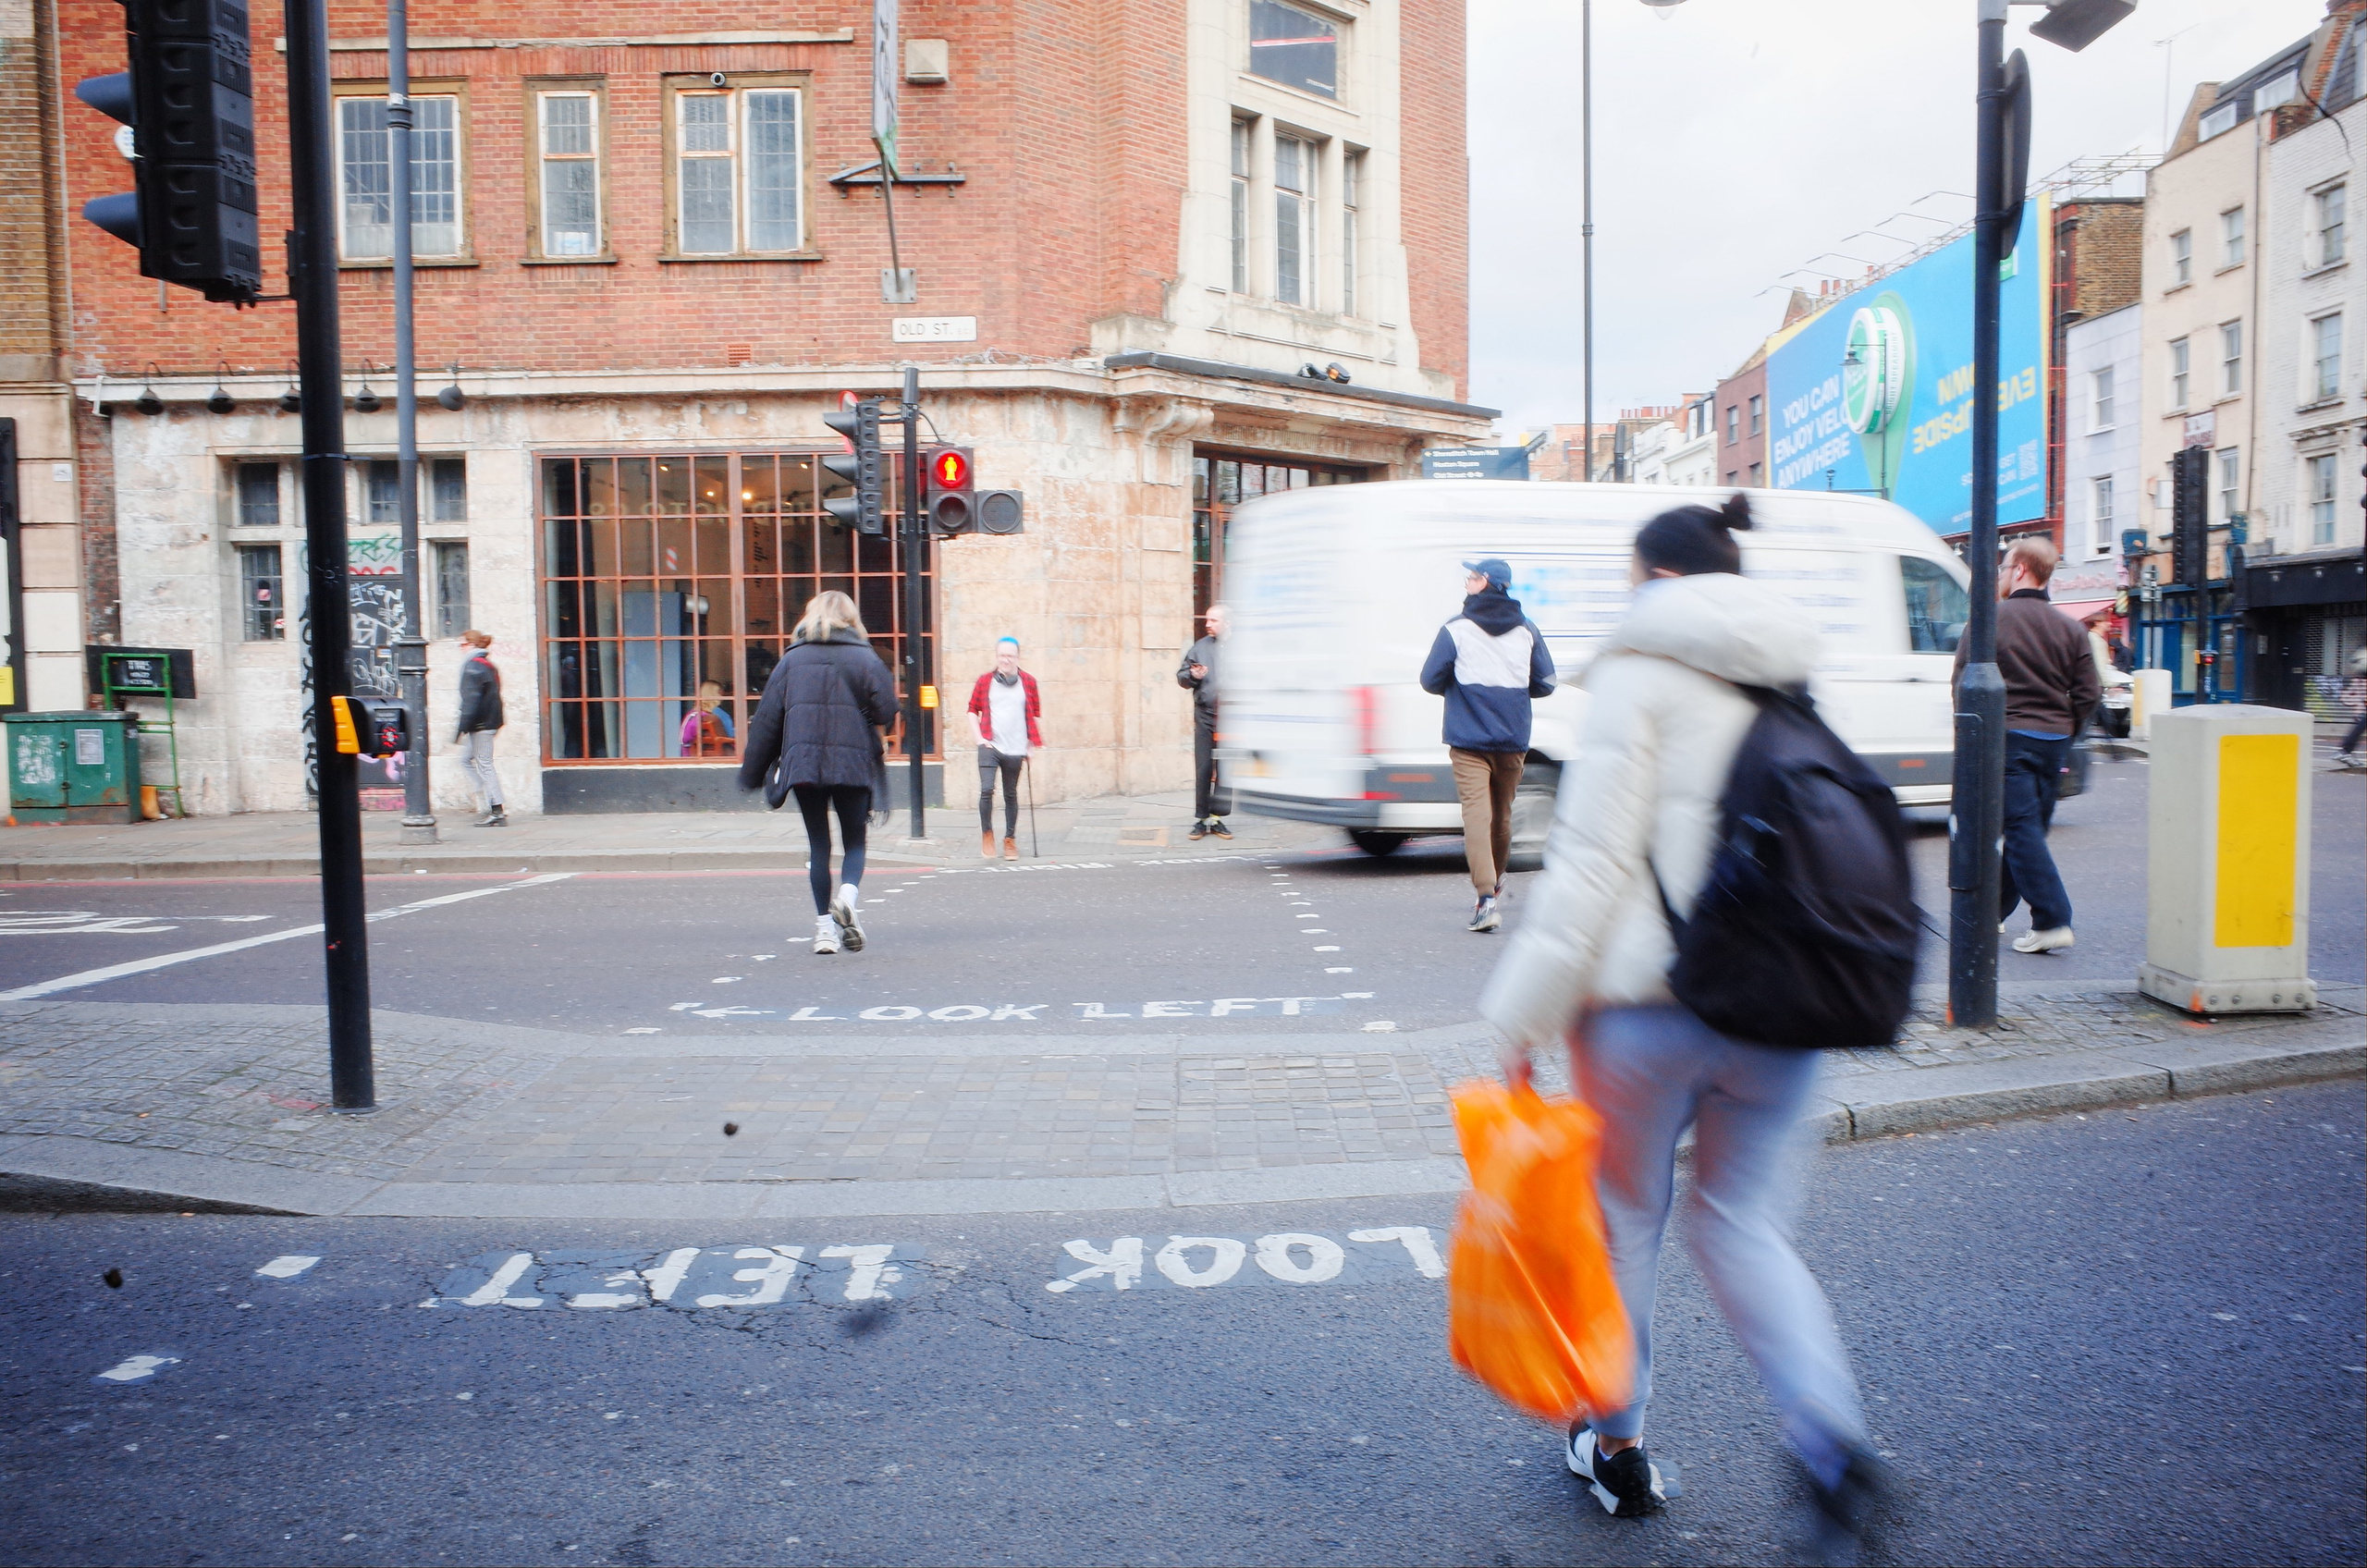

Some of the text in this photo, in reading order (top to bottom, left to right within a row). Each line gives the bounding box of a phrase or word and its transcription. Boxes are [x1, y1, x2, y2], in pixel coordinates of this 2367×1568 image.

[900, 324, 926, 335] OLD
[1782, 394, 1809, 429] YOU
[1809, 374, 1839, 411] CAN
[1997, 366, 2035, 412] EVE
[1774, 420, 1815, 464] ENJOY
[1777, 431, 1850, 489] ANYWHERE
[789, 998, 1341, 1022] LOOK LEFT
[1045, 1226, 1449, 1292] LOOK
